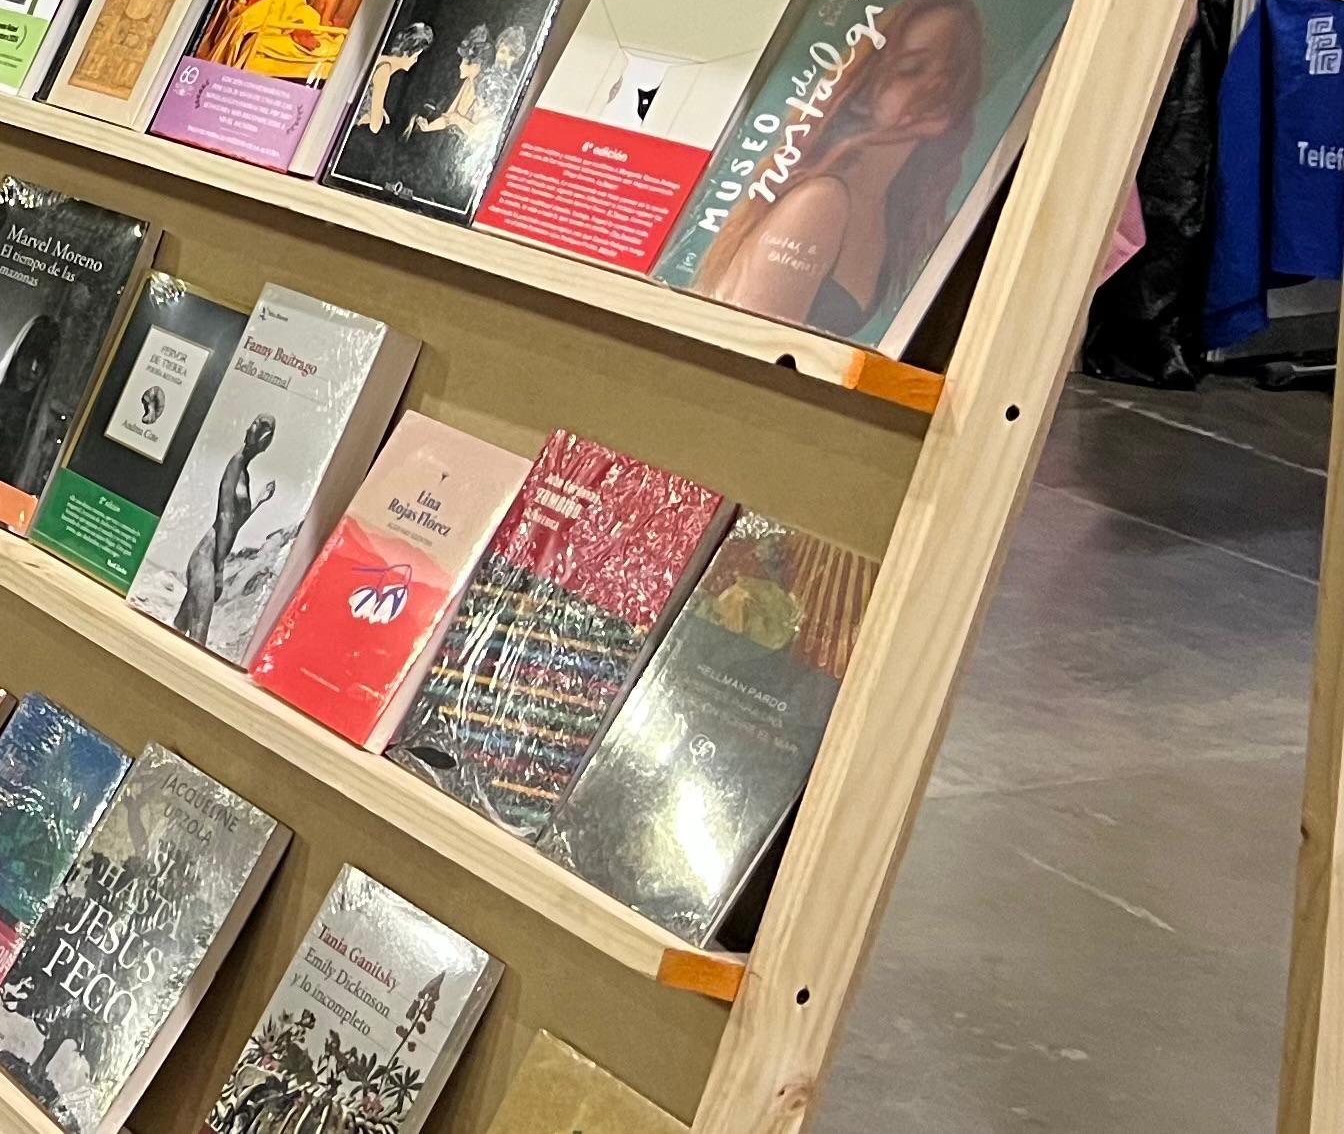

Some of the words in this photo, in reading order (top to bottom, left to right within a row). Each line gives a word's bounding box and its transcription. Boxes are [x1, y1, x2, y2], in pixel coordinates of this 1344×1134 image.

[791, 66, 817, 96] de
[699, 113, 780, 233] MUSEO
[0, 244, 13, 258] El
[13, 252, 46, 272] tiempo
[47, 262, 61, 276] de
[62, 266, 75, 282] las
[7, 224, 52, 253] Marvel
[52, 240, 102, 272] Moreno
[234, 357, 258, 376] Bello
[258, 370, 292, 391] animal
[244, 336, 273, 361] Fanny
[273, 347, 317, 377] Buitrago
[388, 498, 416, 520] Rojas
[417, 511, 451, 536] Flórez
[417, 490, 441, 511] Lina
[747, 688, 787, 712] PARDO
[161, 773, 241, 833] JACQUELINE
[164, 806, 212, 846] URZOLA
[150, 846, 175, 882] SI
[97, 860, 181, 940] HASTA
[318, 924, 348, 956] Tania
[349, 947, 399, 993] Ganitsky
[304, 947, 336, 981] Emily
[335, 969, 390, 1018] Dickinson
[291, 973, 301, 986] y
[300, 974, 312, 993] lo
[311, 983, 371, 1036] incompleto
